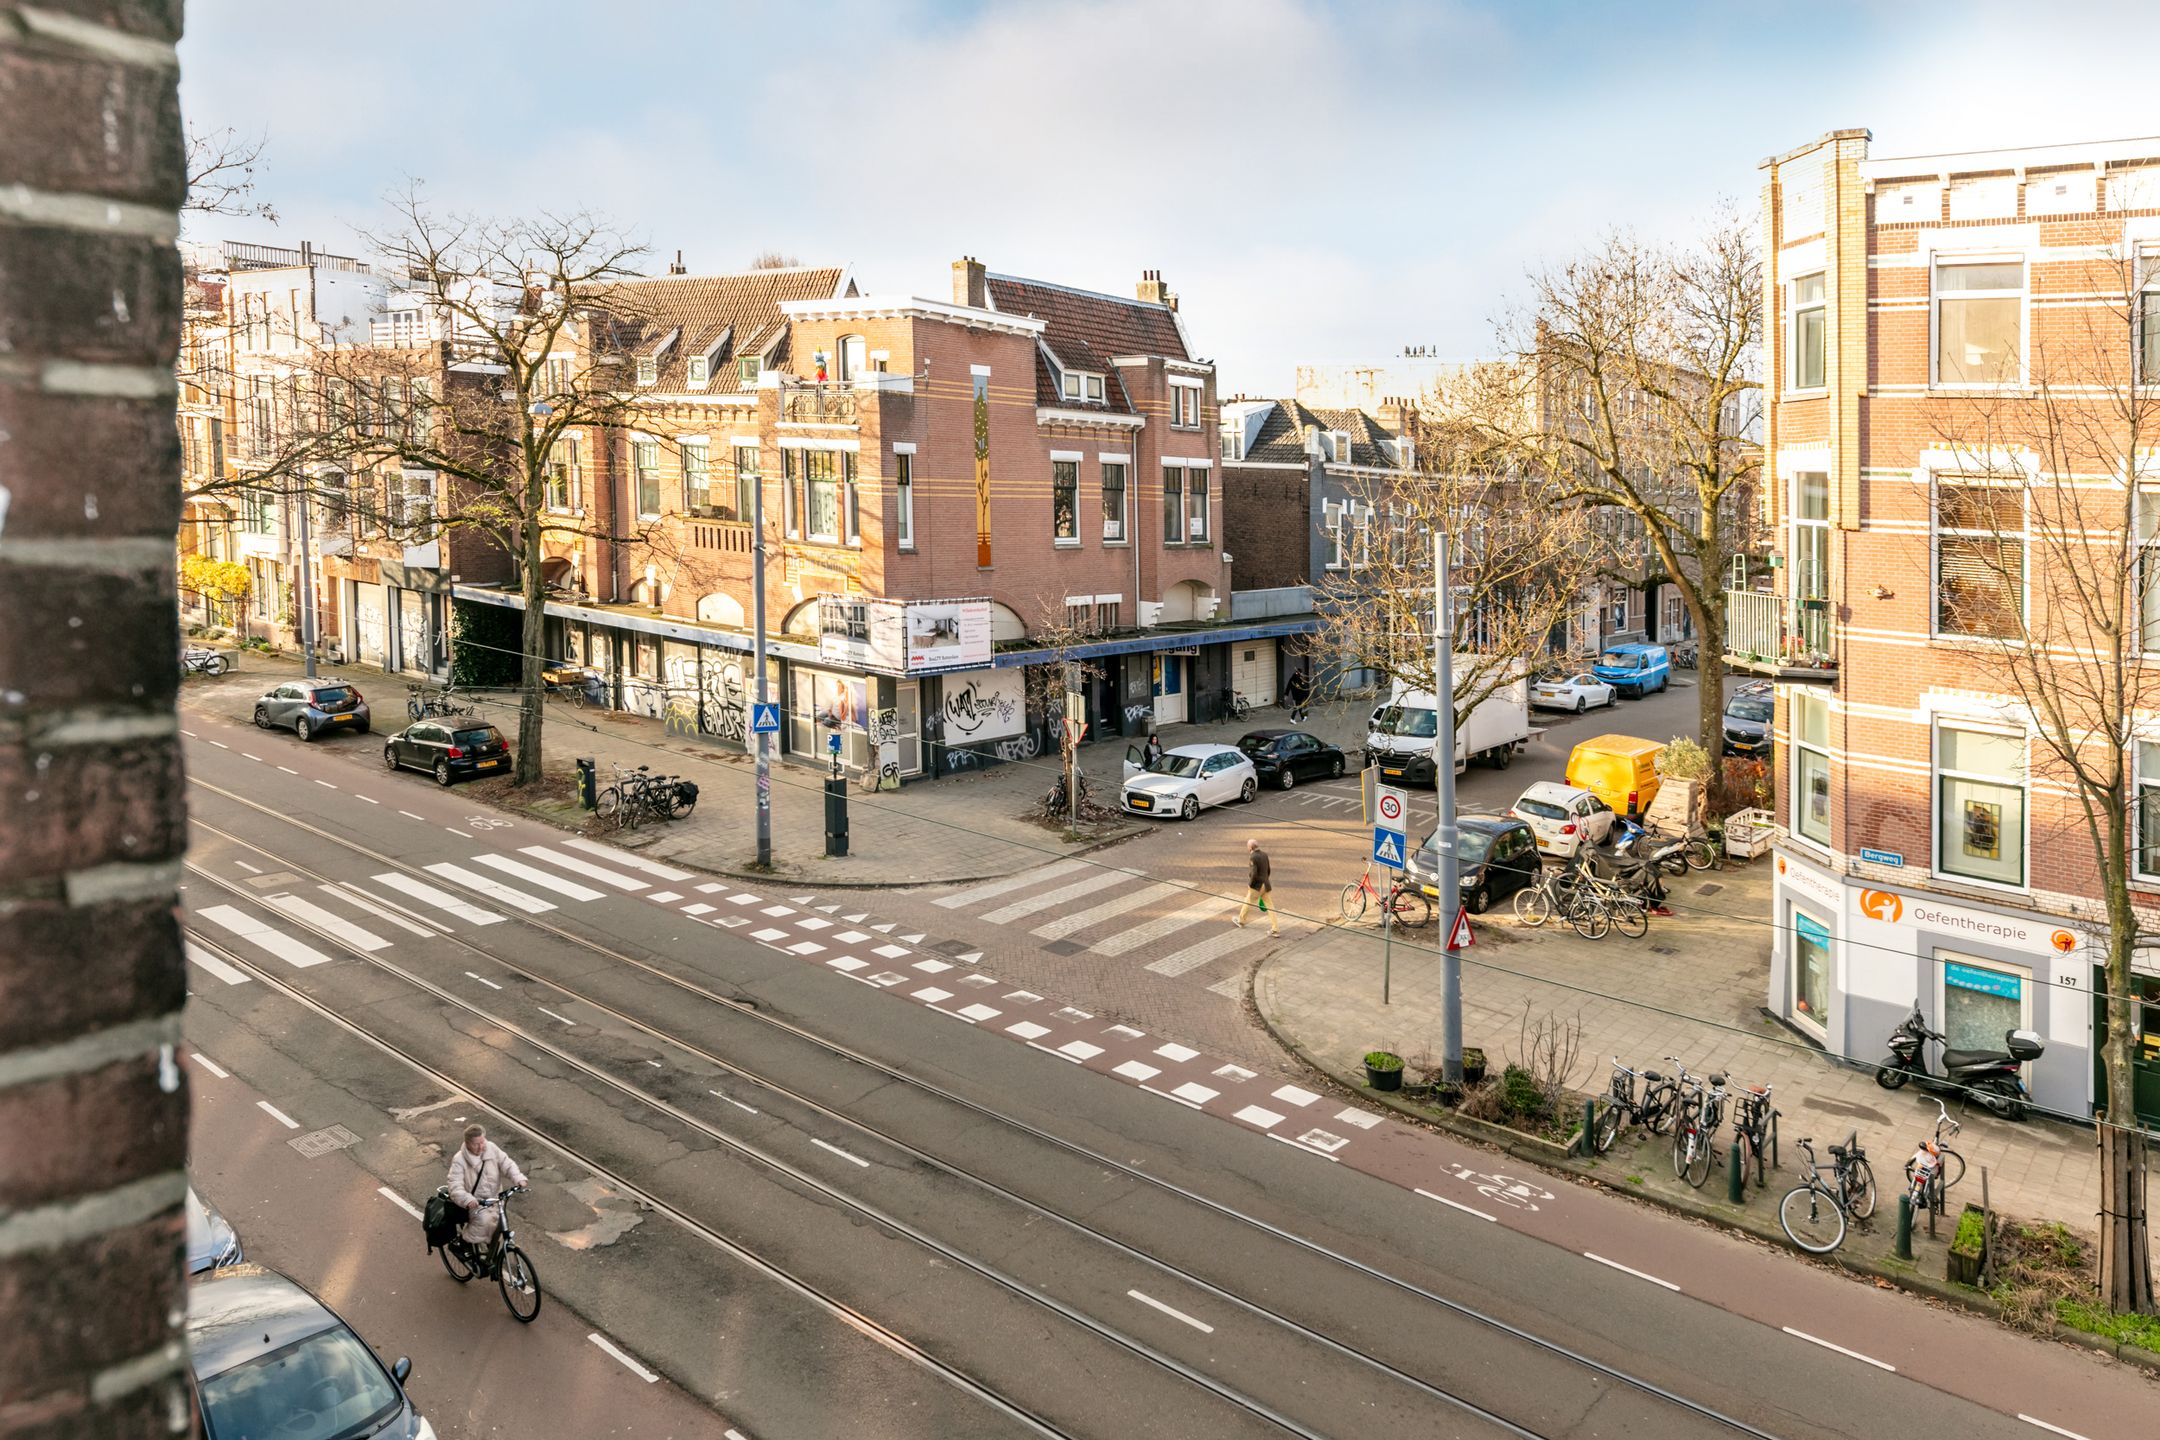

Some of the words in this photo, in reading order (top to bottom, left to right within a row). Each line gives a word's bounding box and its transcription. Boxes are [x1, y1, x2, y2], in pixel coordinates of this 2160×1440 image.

[1384, 801, 1397, 813] 30
[1864, 850, 1899, 865] Bergweg
[1790, 866, 1840, 902] Oefentherapie
[1914, 907, 2027, 940] Oefentherapie
[2059, 975, 2076, 987] 157
